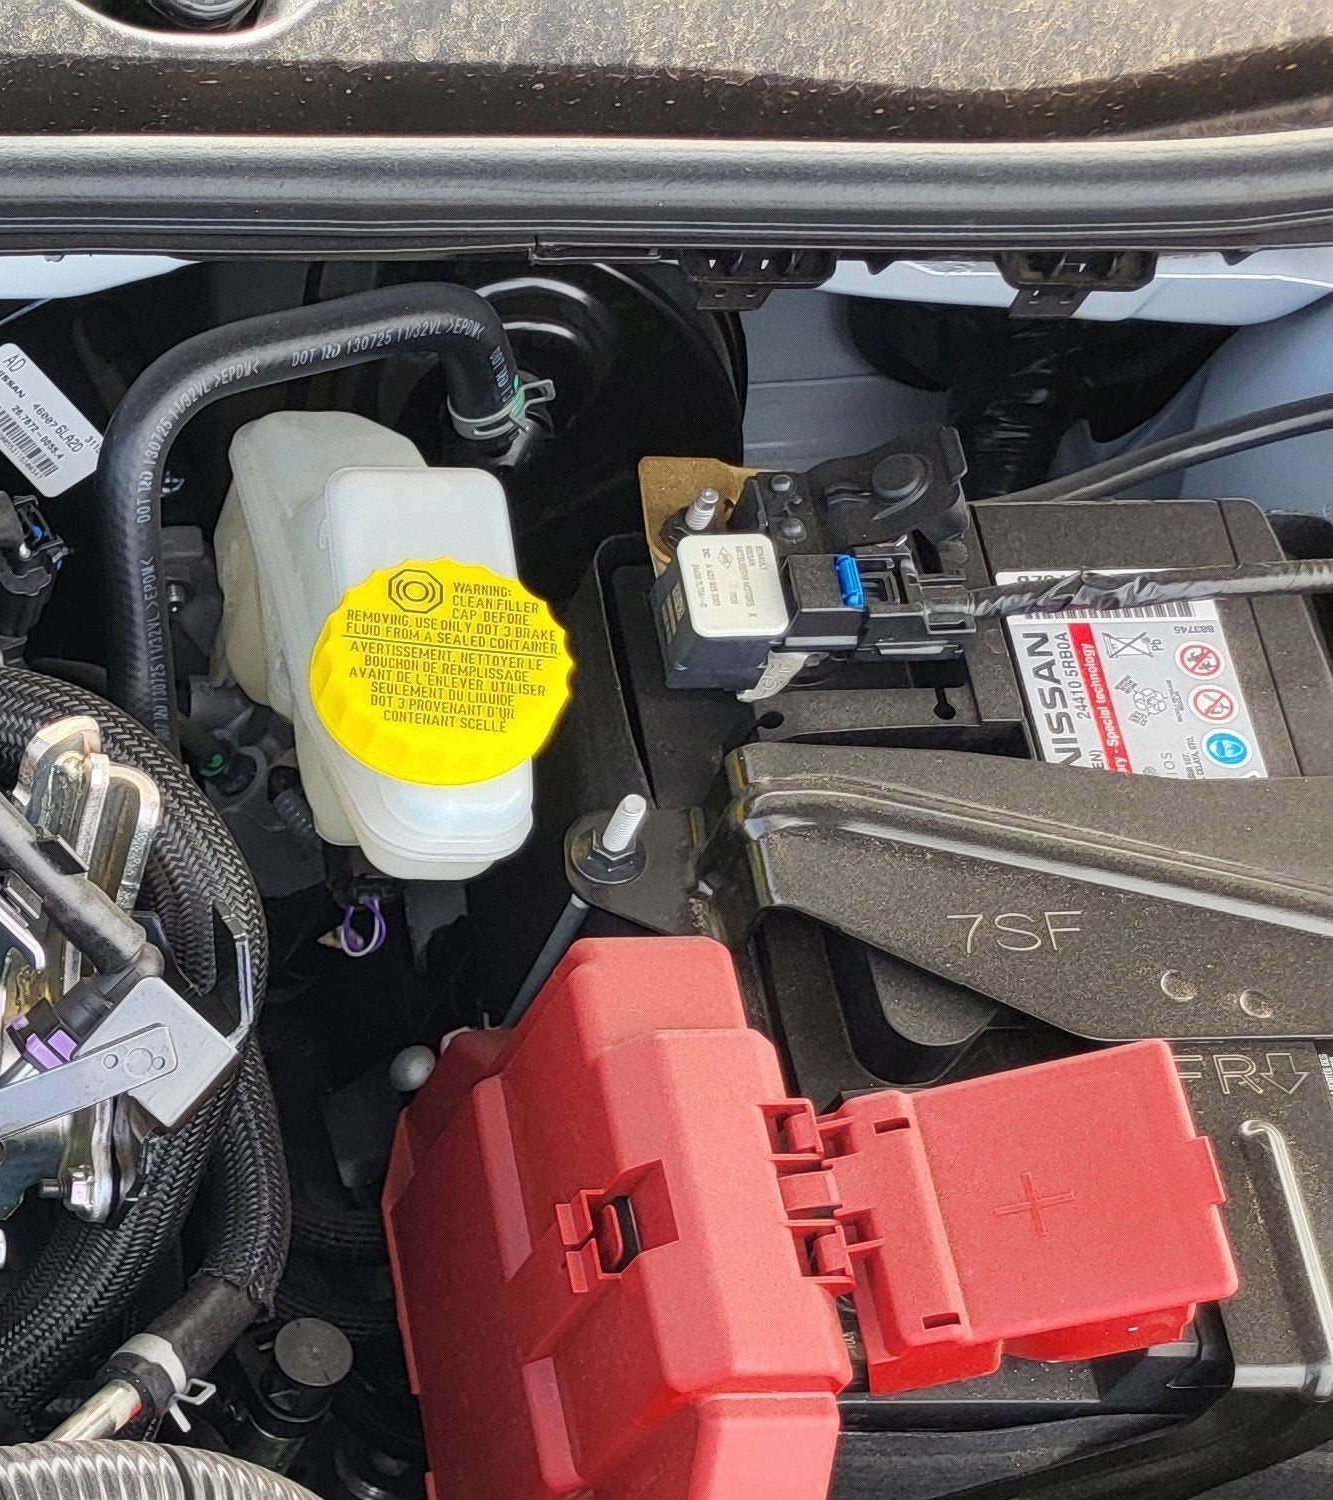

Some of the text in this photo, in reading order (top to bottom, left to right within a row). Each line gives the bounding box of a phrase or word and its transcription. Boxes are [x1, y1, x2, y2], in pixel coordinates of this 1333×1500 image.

[292, 349, 314, 367] DOT
[346, 329, 392, 354] 130725
[3, 354, 27, 372] AD
[33, 403, 59, 427] 46007
[143, 418, 173, 465] 130725
[136, 498, 152, 524] DOT
[453, 581, 512, 597] WARNING:
[452, 594, 539, 614] CLEAN FILLER
[416, 616, 438, 630] USE
[441, 618, 473, 634] ONLY
[476, 622, 500, 636] DOT
[503, 625, 512, 638] 3
[515, 626, 556, 642] BRAKE
[452, 608, 530, 627] CAP BEFORE
[346, 622, 561, 656] FLUID FROM A SEALED CONTAINER.
[1151, 639, 1165, 652] Pb
[364, 655, 529, 682] BOUCHON DE REMPLISSAGE
[461, 652, 524, 669] NETTOYER
[528, 659, 543, 671] LE
[1081, 643, 1109, 706] technology
[349, 666, 392, 681] AVANT
[396, 671, 412, 683] DE
[491, 679, 546, 697] UTILISER
[371, 682, 515, 707] SEULEMENT DU LIQUIDE
[370, 693, 394, 707] DOT
[397, 697, 405, 709] 3
[409, 698, 483, 716] PROVENANT
[1022, 631, 1084, 766] NISSAN
[1069, 680, 1092, 720] 24410
[383, 709, 456, 729] CONTENANT
[1098, 705, 1122, 748] Special
[946, 910, 1082, 954] 7SF
